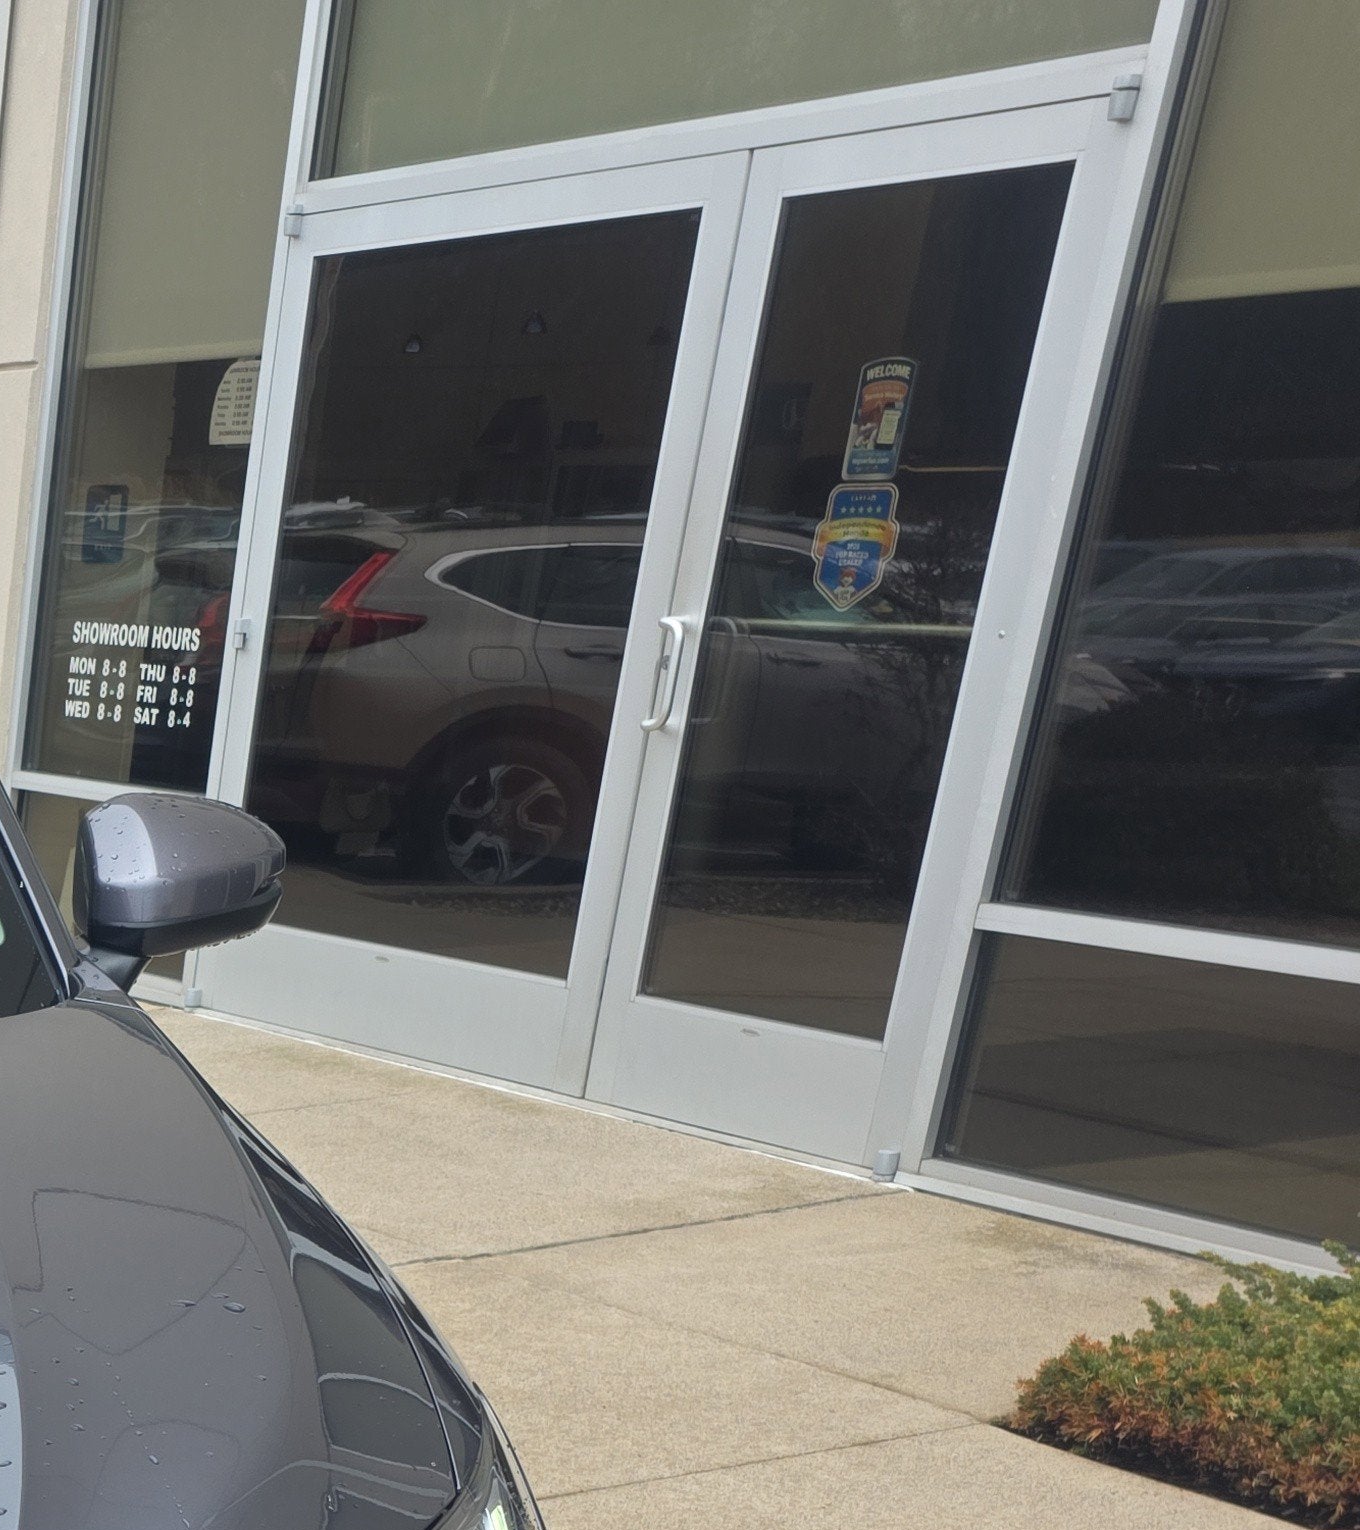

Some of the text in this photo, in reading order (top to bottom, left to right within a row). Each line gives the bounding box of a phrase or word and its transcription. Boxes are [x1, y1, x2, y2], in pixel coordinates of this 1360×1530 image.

[866, 364, 911, 381] WELCOME
[72, 621, 201, 651] SHOWROOM HOURS
[69, 656, 97, 675] MON
[139, 663, 166, 682] THU
[68, 678, 91, 697] TUE
[136, 685, 157, 704] FRI
[64, 700, 90, 719] WED
[133, 706, 160, 726] SAT
